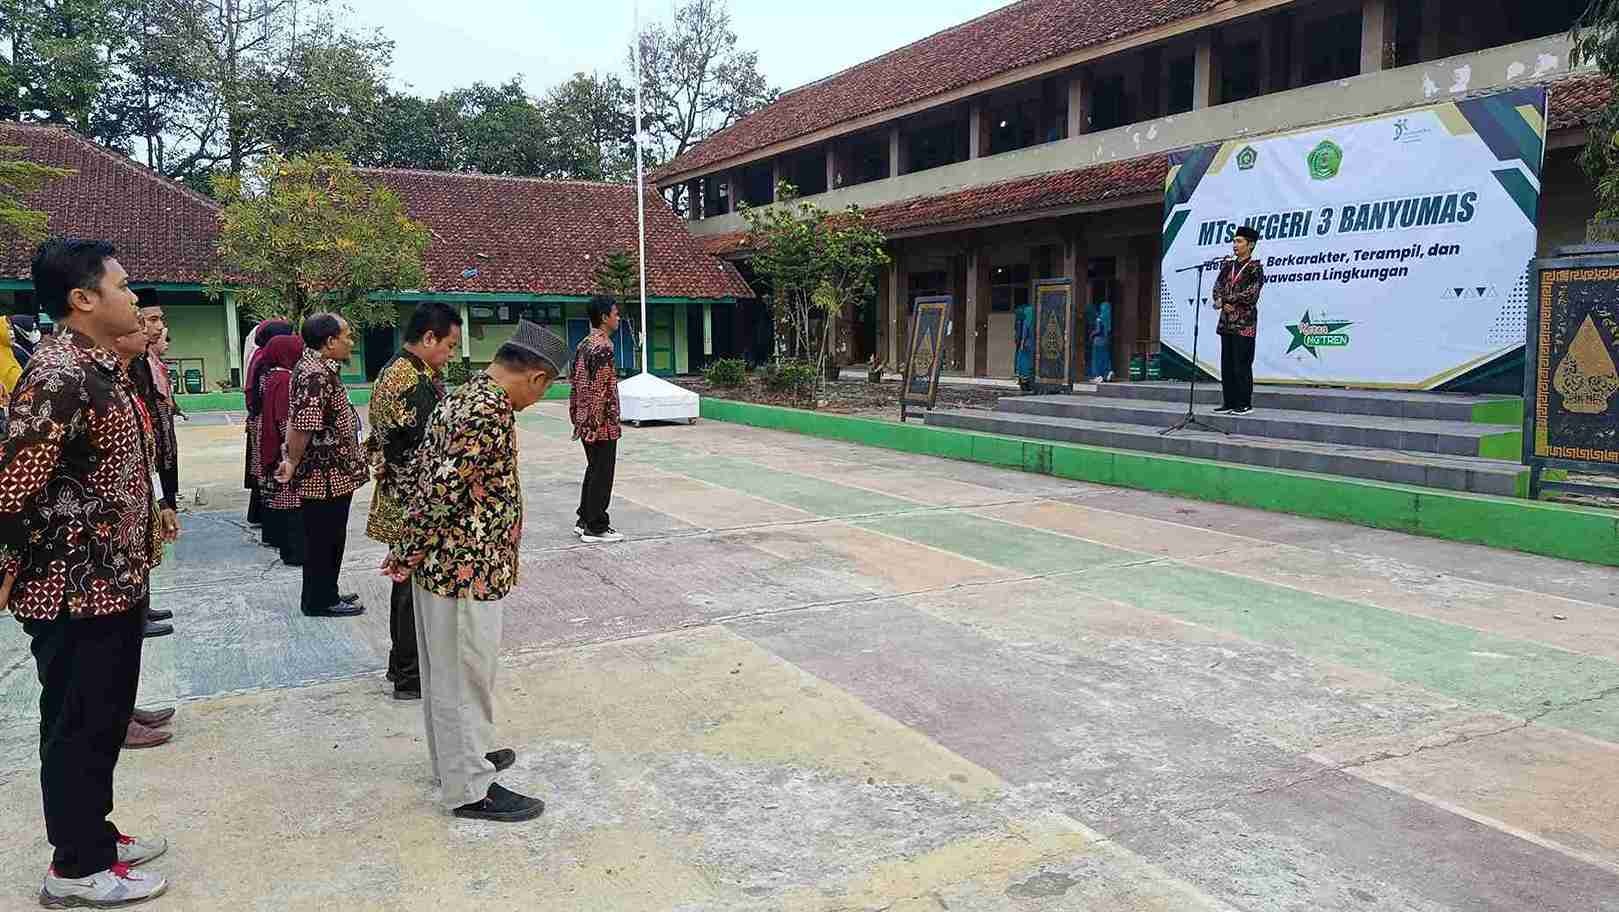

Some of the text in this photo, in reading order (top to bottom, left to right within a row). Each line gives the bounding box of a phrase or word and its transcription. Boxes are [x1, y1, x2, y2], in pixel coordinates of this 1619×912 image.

[1317, 207, 1334, 236] 3
[1338, 191, 1478, 233] BANYUMAS
[1266, 243, 1460, 267] Berkarakter, Terampil, dan
[1322, 266, 1409, 283] Lingkungan
